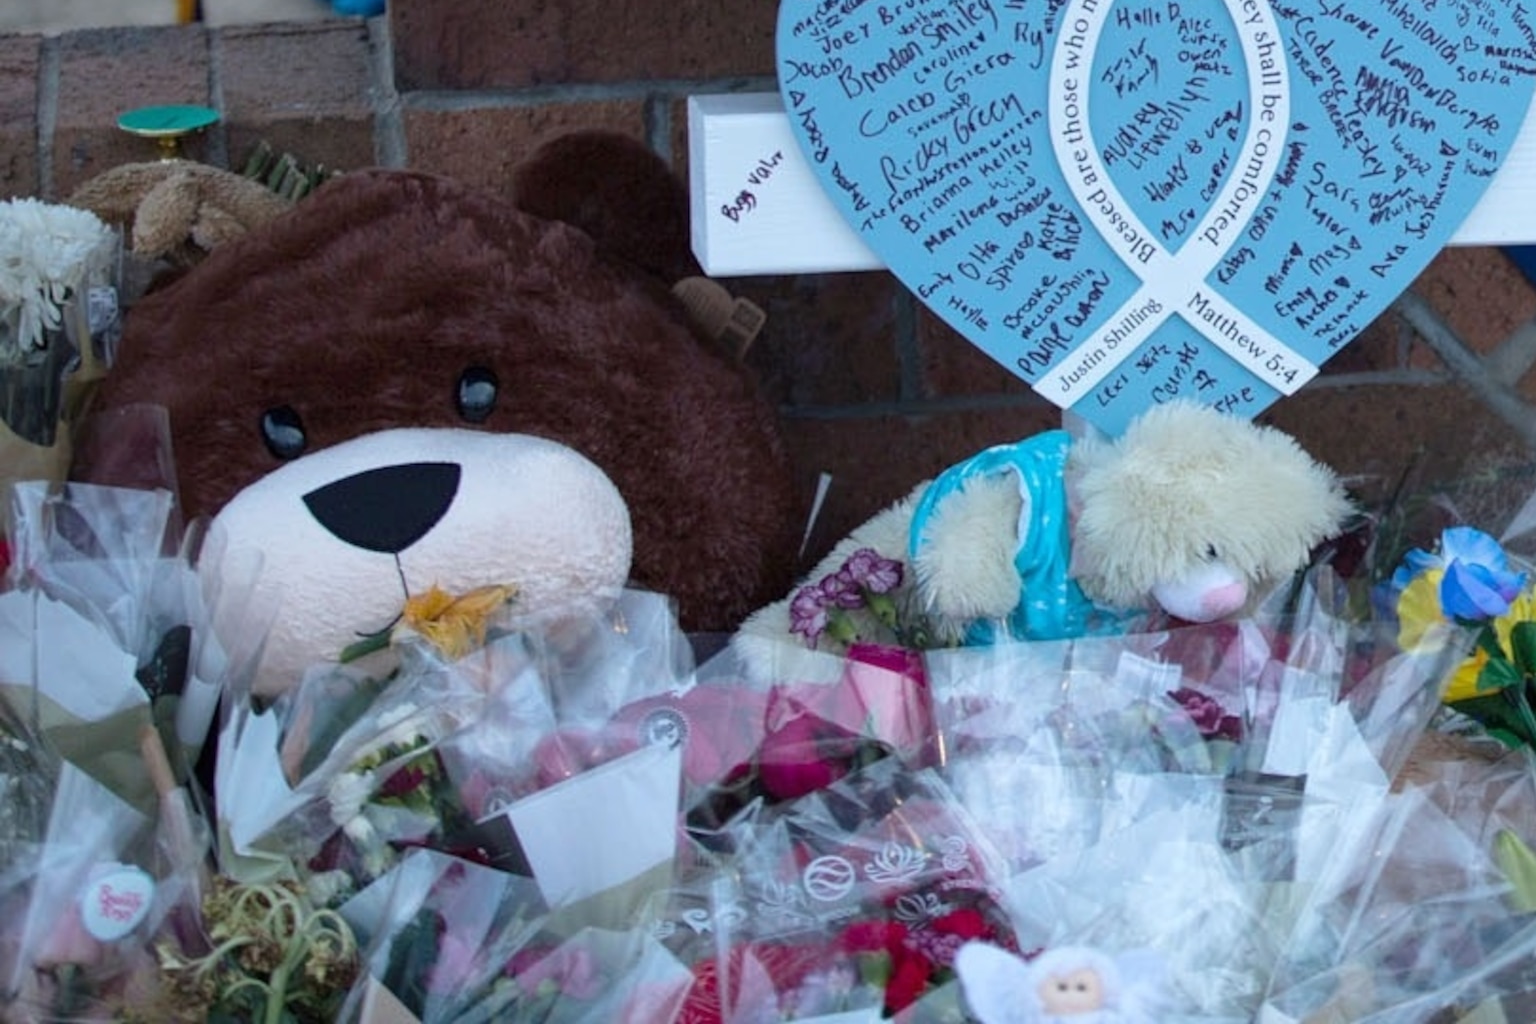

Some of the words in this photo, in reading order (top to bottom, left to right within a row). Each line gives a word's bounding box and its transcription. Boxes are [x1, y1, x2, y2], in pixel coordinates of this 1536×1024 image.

[1063, 17, 1090, 71] who
[1254, 32, 1282, 86] shall
[1062, 77, 1085, 144] those
[1261, 94, 1283, 123] be
[1073, 149, 1099, 186] are
[1198, 126, 1273, 248] comforted.
[1088, 188, 1158, 264] Blessed
[1058, 347, 1107, 394] Justin
[1103, 296, 1164, 351] Shilling
[1186, 290, 1267, 359] Matthew
[1265, 353, 1300, 385] 5:4
